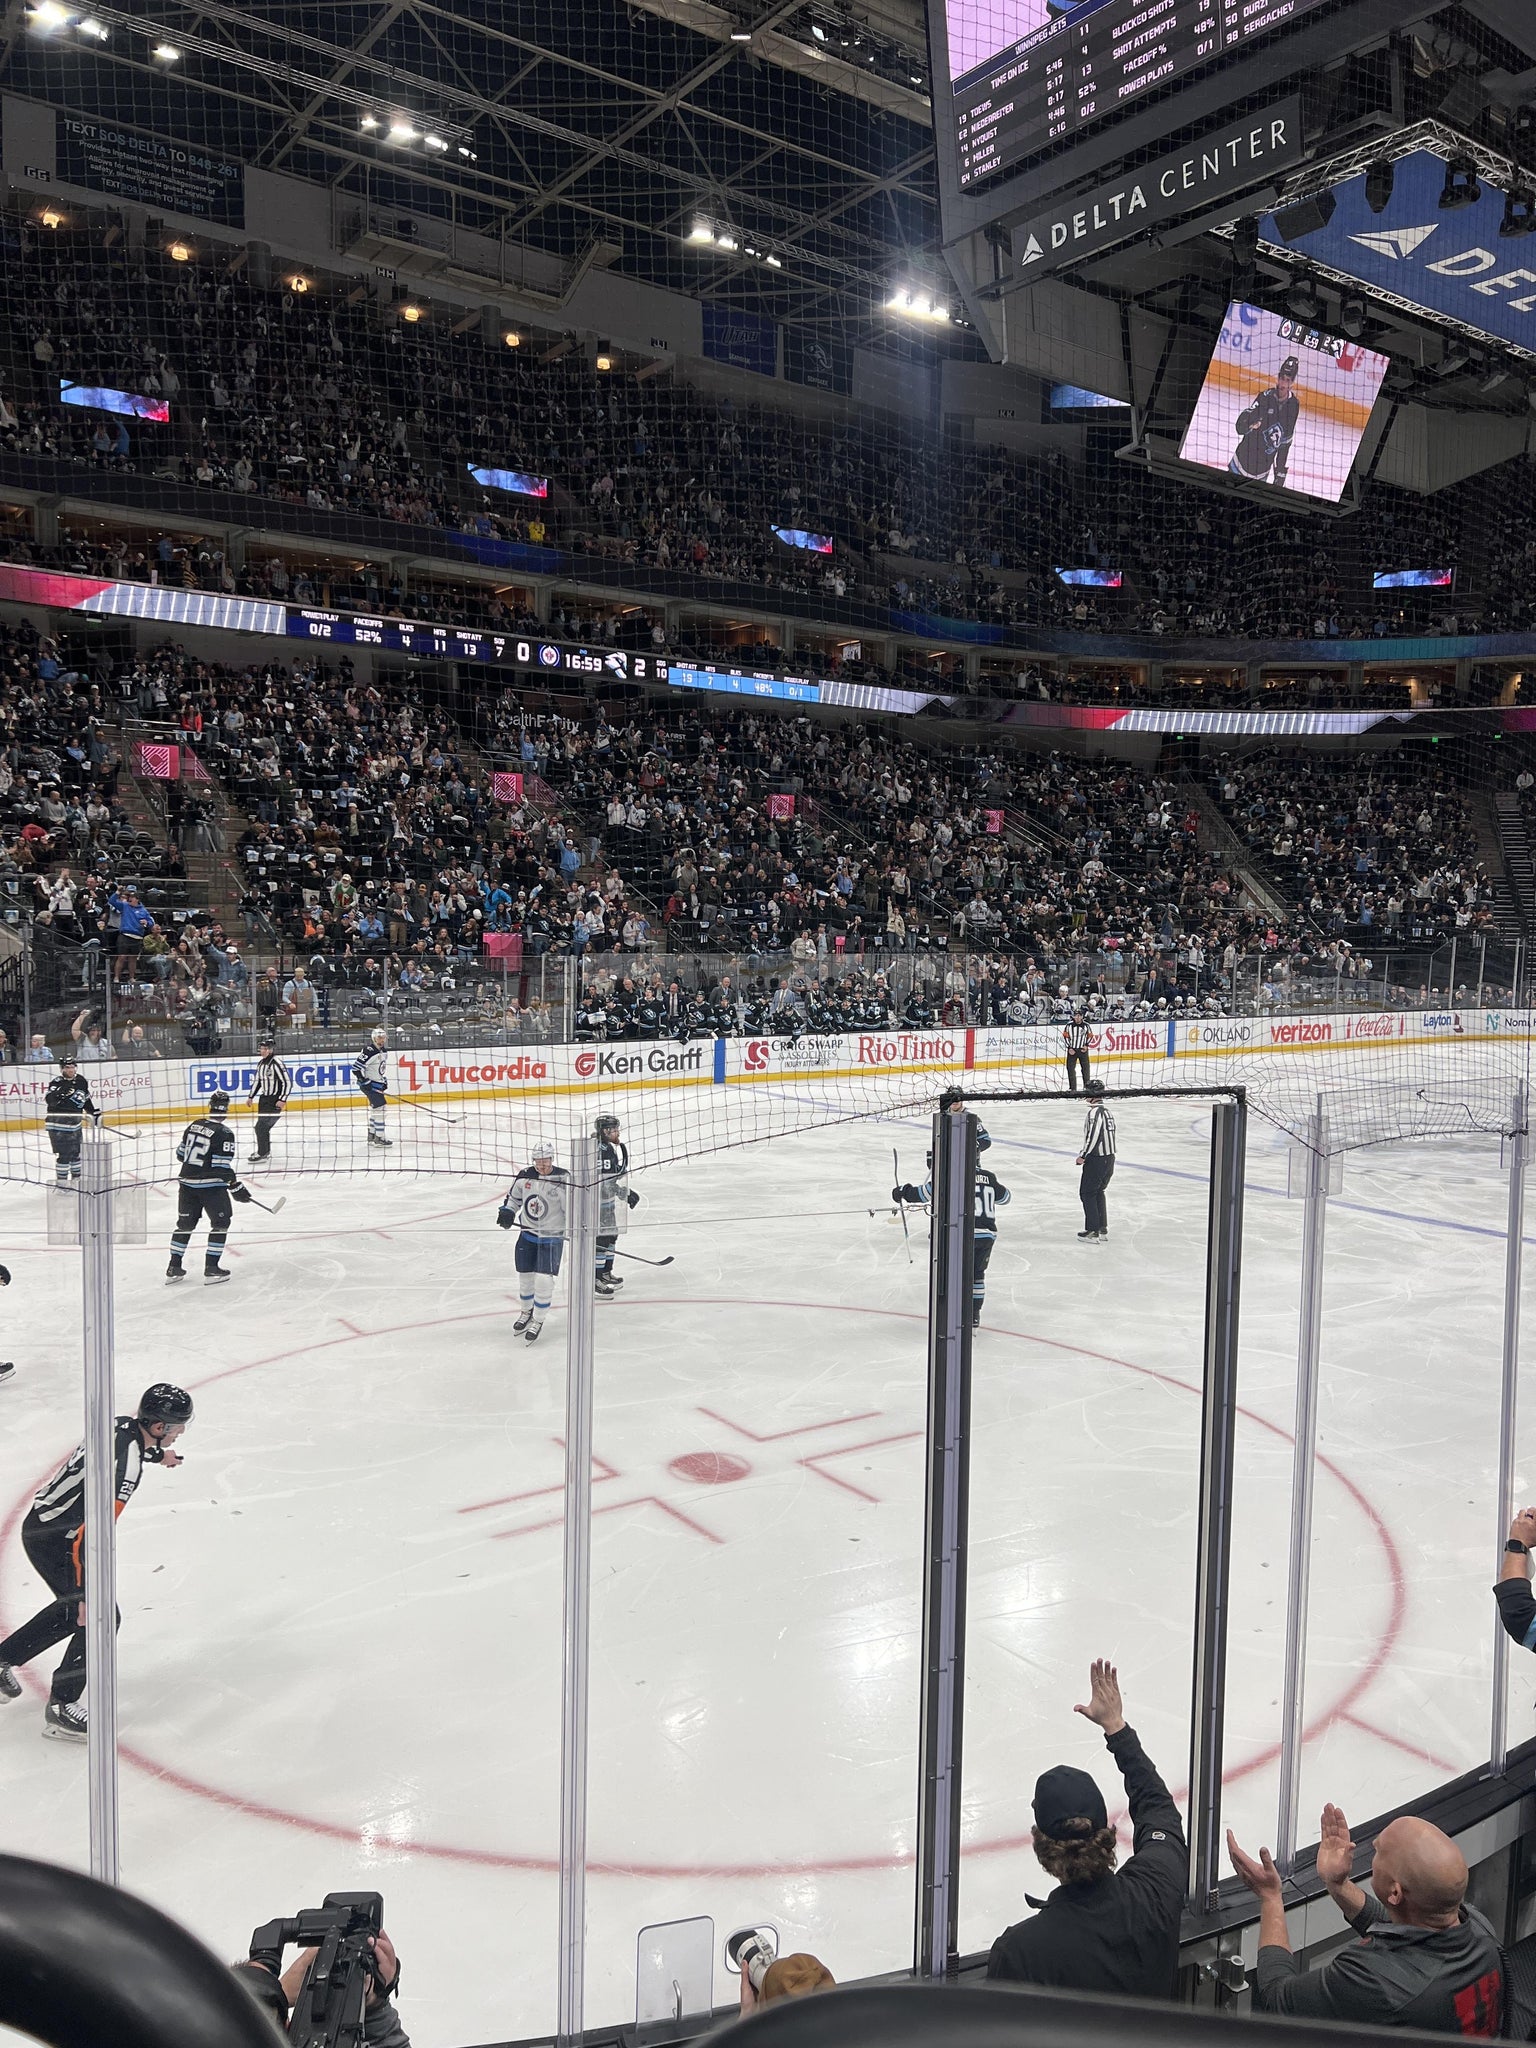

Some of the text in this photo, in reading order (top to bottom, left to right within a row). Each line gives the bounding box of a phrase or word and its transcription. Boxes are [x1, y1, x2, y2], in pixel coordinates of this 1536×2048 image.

[1113, 0, 1174, 38] BLOCKED SHOTS
[1194, 17, 1215, 34] 48%
[1226, 13, 1237, 26] 50
[1226, 1, 1294, 44] 98 SERGACHEV
[1015, 18, 1067, 55] WINNIPEG JETS
[1079, 24, 1089, 36] 11
[1113, 16, 1177, 60] SHOT ATTEMPTS
[1081, 46, 1088, 55] 4
[1197, 39, 1212, 55] 0/1
[1123, 44, 1167, 74] FACEOFF %
[991, 60, 1029, 89] TIME ON ICE
[1082, 64, 1092, 76] 13
[1118, 61, 1174, 98] POWER PLAYS
[1078, 81, 1096, 98] 52%
[958, 114, 967, 124] 19
[970, 100, 992, 118] TOEWS
[1081, 102, 1096, 117] 0/2
[64, 119, 97, 137] TEXT
[99, 128, 126, 146] SOS
[128, 137, 167, 157] DELTA
[169, 148, 186, 162] TO
[961, 144, 969, 153] 14
[972, 127, 998, 147] NYQUIST
[27, 167, 46, 180] GG
[961, 173, 970, 184] 64
[974, 156, 1001, 177] STANLEY
[101, 177, 120, 189] TEXT
[1051, 119, 1286, 248] DELTA CENTER
[377, 267, 394, 279] HH
[722, 326, 760, 345] UTAH
[309, 623, 331, 636] 0/2
[356, 629, 381, 643] 52%
[402, 635, 410, 646] 4
[434, 639, 446, 651] 11
[464, 644, 476, 655] 13
[496, 646, 503, 657] 7
[517, 642, 530, 661] 0
[566, 654, 602, 672] 16:59
[635, 658, 645, 677] 2
[656, 668, 667, 678] 10
[733, 680, 738, 688] 4
[1423, 1013, 1452, 1029] Layton
[1203, 1026, 1250, 1042] OKLAND
[1271, 1019, 1332, 1042] verizon
[808, 1039, 843, 1050] SWAPP
[1105, 1027, 1157, 1052] Smith's
[422, 1056, 547, 1084] Trucordia
[600, 1048, 703, 1075] Ken Garff
[120, 1077, 151, 1087] CARE
